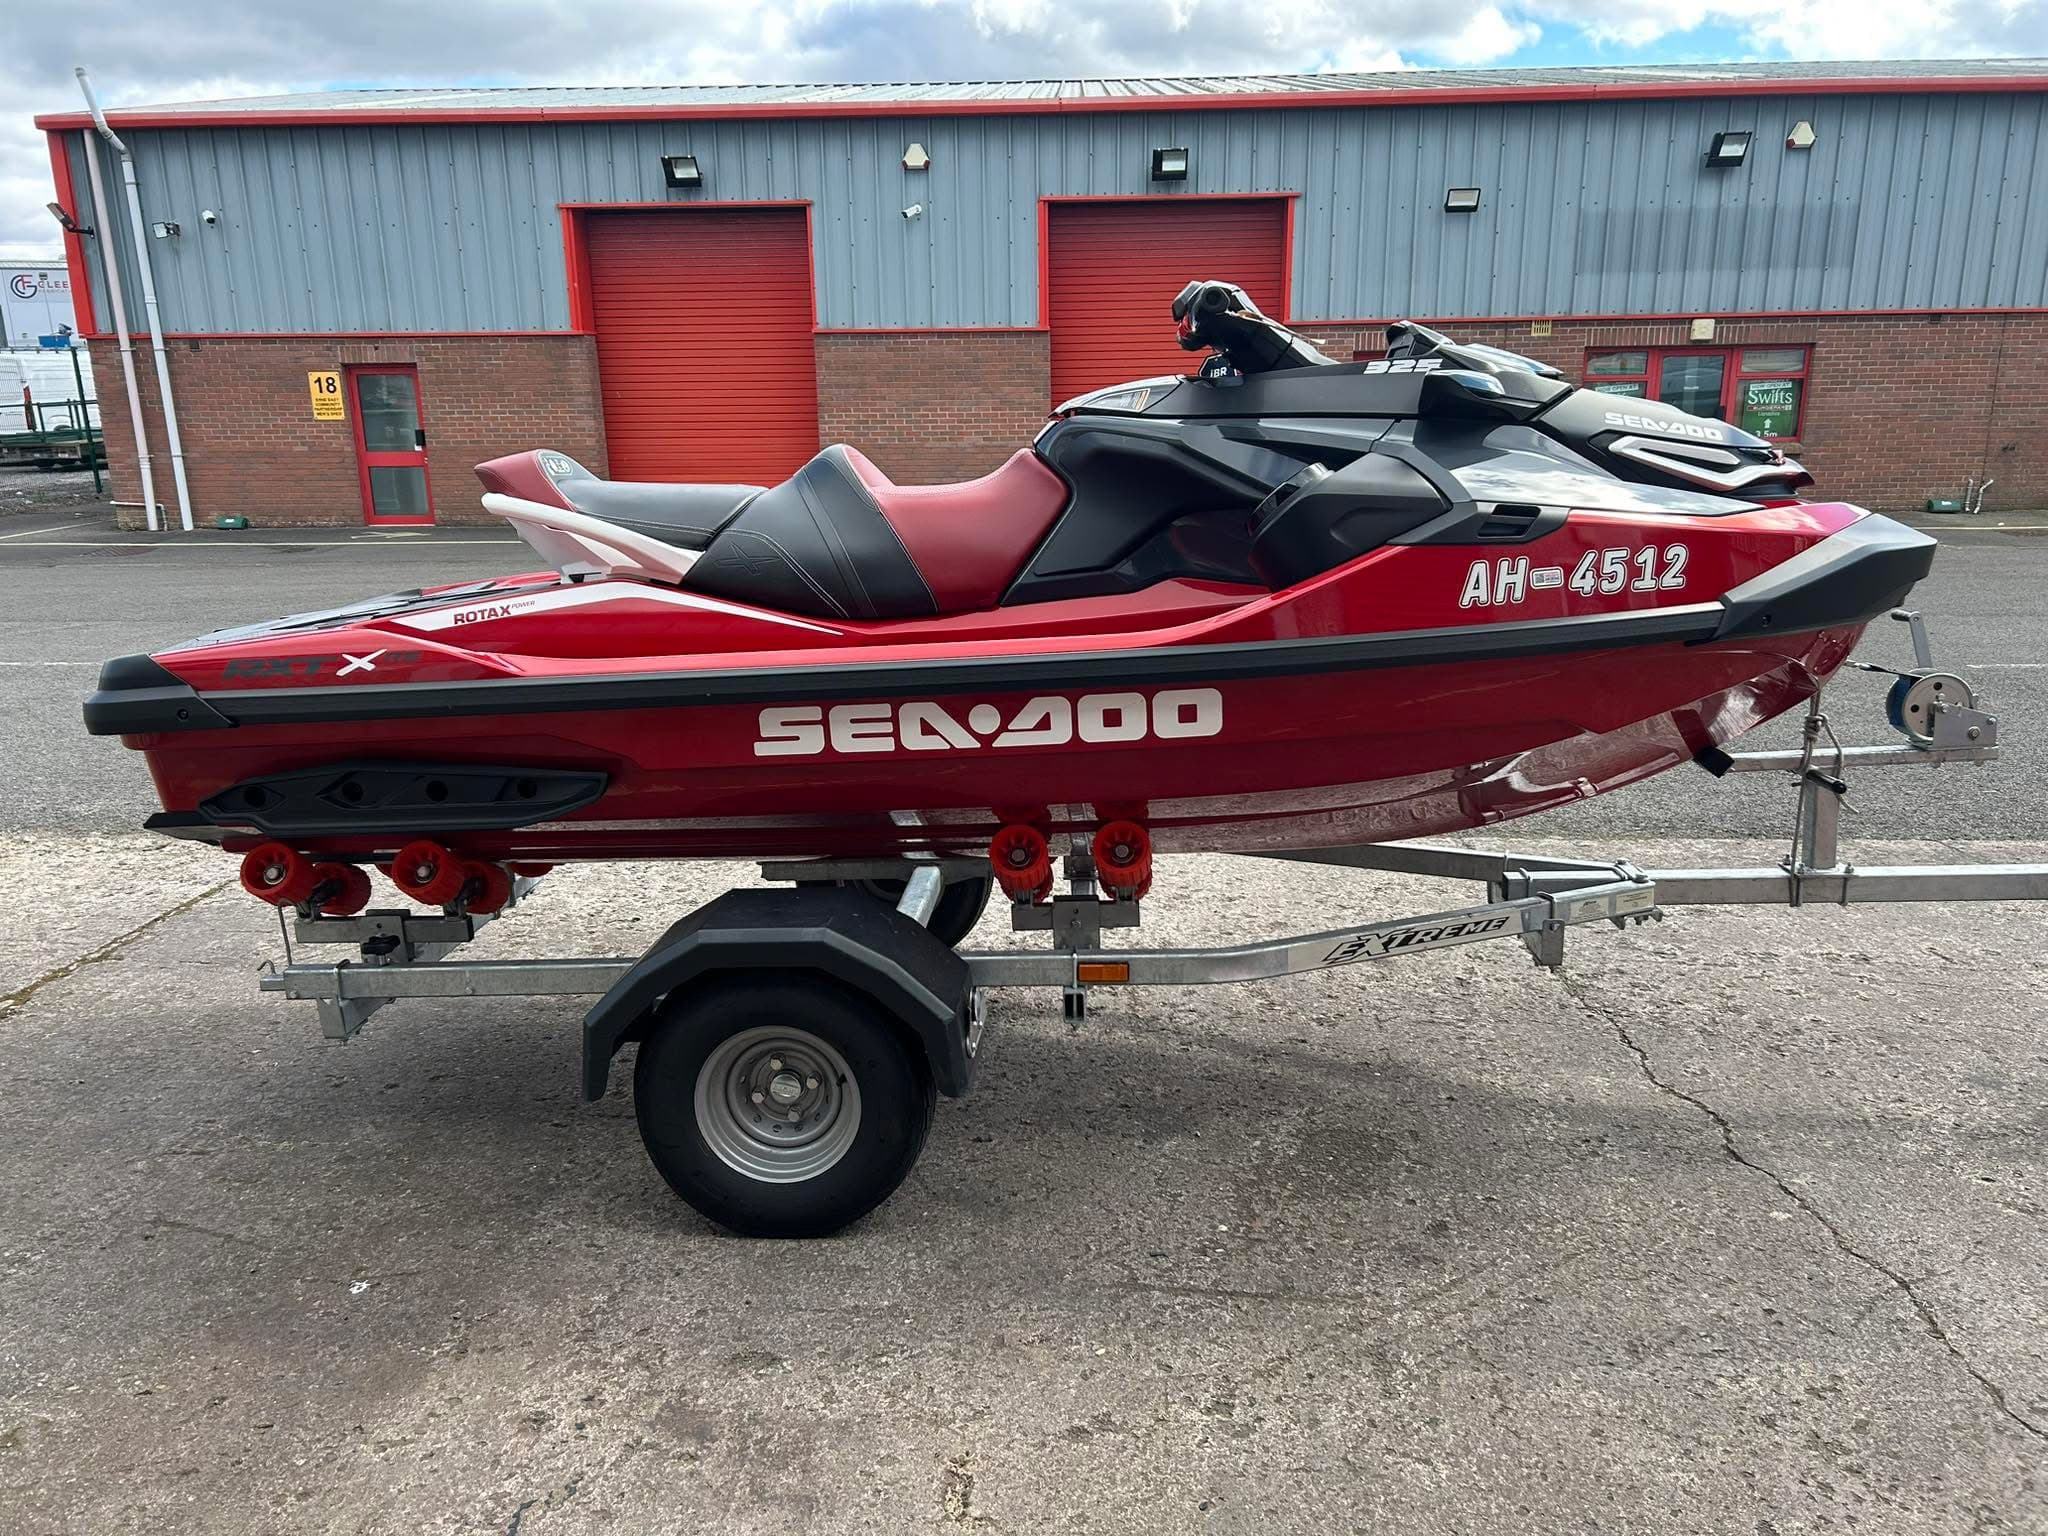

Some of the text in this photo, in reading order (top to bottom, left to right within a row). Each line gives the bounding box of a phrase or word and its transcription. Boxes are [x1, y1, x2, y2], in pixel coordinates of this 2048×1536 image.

[1363, 358, 1443, 374] 325
[313, 376, 337, 394] 18
[1747, 389, 1793, 405] Swifts
[453, 600, 536, 625] ROTAX POWER
[223, 655, 337, 679] RXT
[335, 648, 388, 677] X
[1321, 916, 1510, 963] EXTREME
